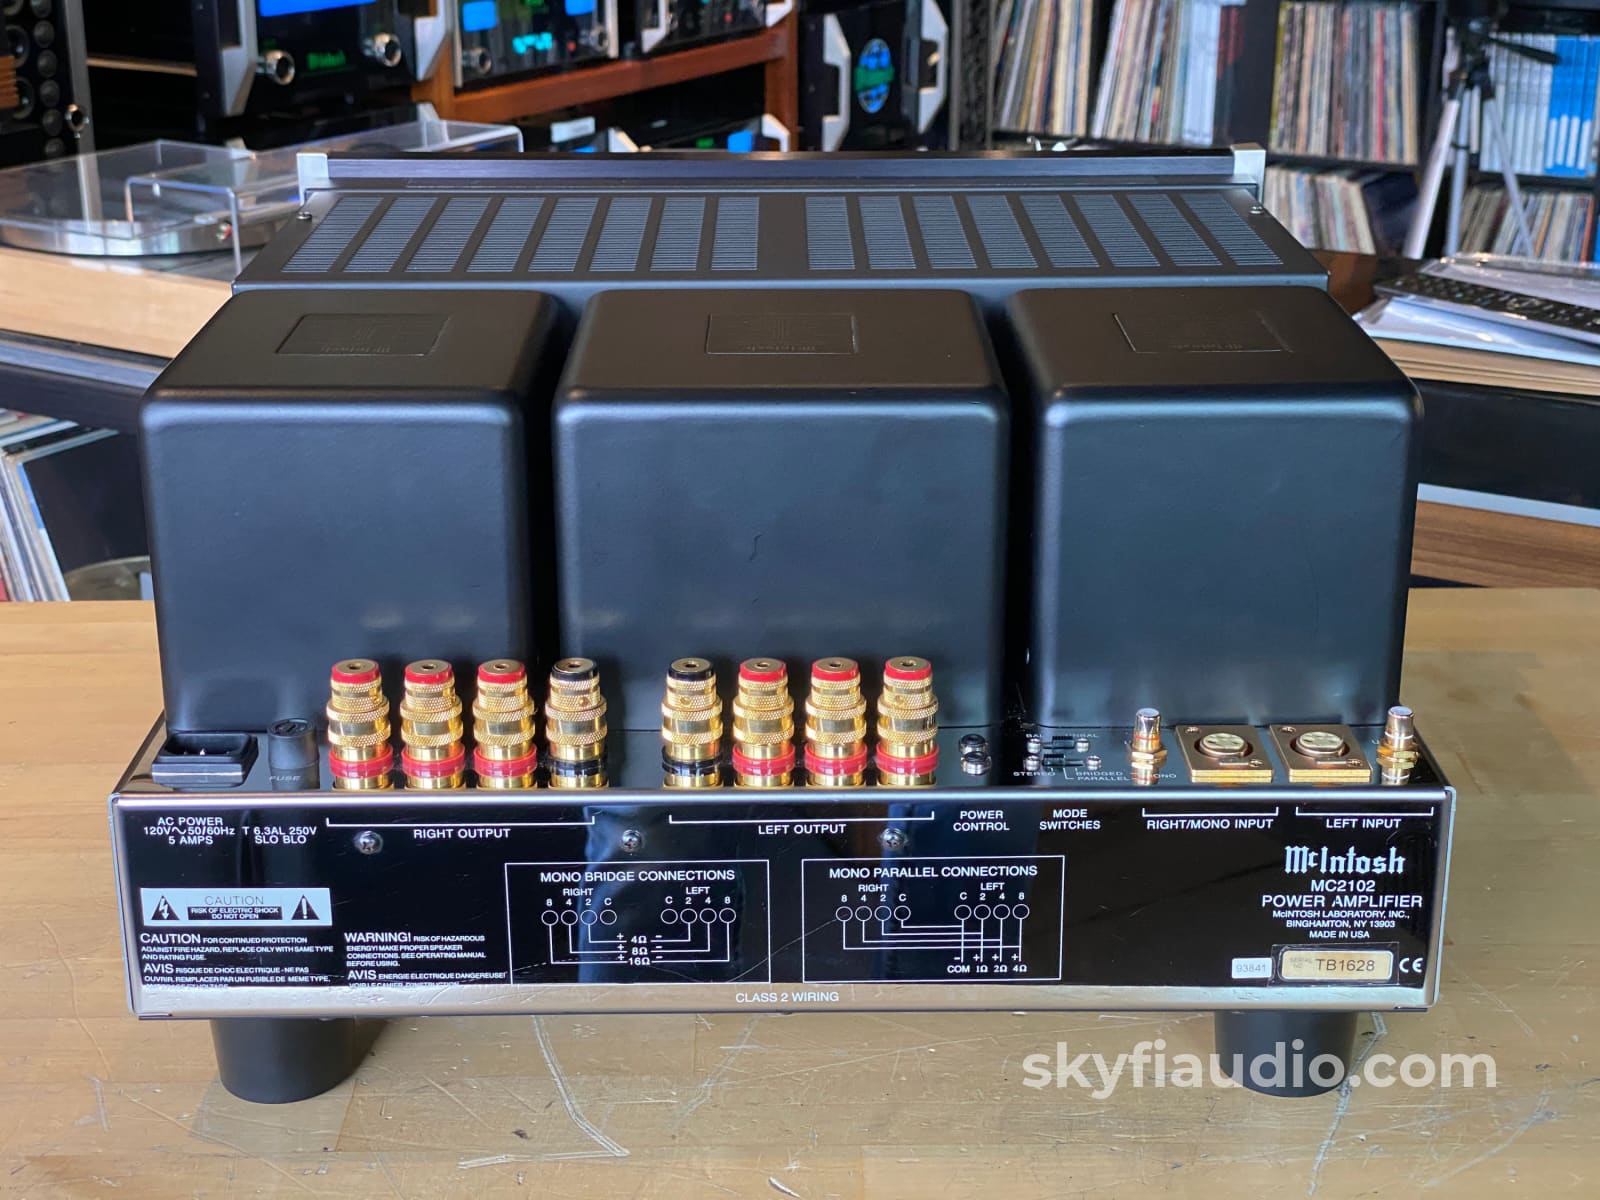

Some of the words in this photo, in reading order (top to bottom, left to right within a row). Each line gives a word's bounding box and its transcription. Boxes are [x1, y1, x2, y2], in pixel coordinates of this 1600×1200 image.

[960, 810, 1003, 820] POWER
[1053, 809, 1087, 818] MODE
[157, 816, 175, 826] AC
[178, 816, 223, 826] POWER
[953, 821, 1009, 831] CONTROL
[1039, 820, 1101, 830] SWITCHES
[1146, 818, 1230, 830] RIGHT/MONO
[1234, 818, 1274, 830] INPUT
[1326, 818, 1359, 829] LEFT
[1362, 818, 1401, 829] INPUT
[253, 826, 286, 836] 6.3AL
[289, 826, 317, 836] 250V
[413, 829, 454, 838] RIGHT
[459, 829, 511, 838] OUTPUT
[758, 824, 789, 834] LEFT
[793, 824, 846, 834] OUTPUT
[168, 836, 176, 845] 5
[179, 836, 213, 845] AMPS
[254, 836, 278, 845] SLO
[282, 836, 307, 845] BLO
[1284, 845, 1406, 874] McIntosh
[540, 872, 582, 883] MONO
[584, 871, 635, 882] BRIDGE
[638, 870, 735, 881] CONNECTIONS
[829, 868, 870, 879] MONO
[873, 867, 938, 878] PARALLEL
[941, 866, 1038, 877] CONNECTIONS
[563, 887, 594, 896] RIGHT
[685, 886, 710, 895] LEFT
[858, 884, 889, 892] RIGHT
[980, 882, 1005, 891] LEFT
[1310, 880, 1376, 893] MC2102
[204, 895, 264, 905] CAUTION
[665, 896, 673, 904] C
[685, 896, 692, 904] 2
[704, 896, 711, 904] 4
[724, 896, 731, 904] 8
[841, 894, 848, 902] 8
[860, 894, 867, 902] 4
[880, 894, 886, 902] 2
[898, 894, 906, 902] C
[959, 892, 967, 900] C
[979, 892, 986, 900] 2
[999, 892, 1005, 900] 4
[1018, 892, 1025, 900] 8
[546, 898, 553, 906] 8
[565, 898, 572, 906] 4
[585, 898, 592, 906] 2
[604, 898, 612, 906] C
[1262, 895, 1325, 908] POWER
[1332, 895, 1422, 908] AMPLIFIER
[1322, 910, 1386, 919] LABORATORY,
[1286, 920, 1351, 928] BINGHAMTON,
[1353, 920, 1367, 928] NY
[1369, 920, 1396, 928] 13903
[140, 933, 201, 944] CAUTION
[344, 932, 411, 942] WARNING!
[144, 964, 174, 973] AVIS
[947, 965, 970, 973] COM
[1314, 958, 1376, 972] TB1628
[347, 970, 377, 980] AVIS
[736, 992, 777, 1002] CLASS
[780, 992, 788, 1002] 2
[791, 992, 839, 1002] WIRING
